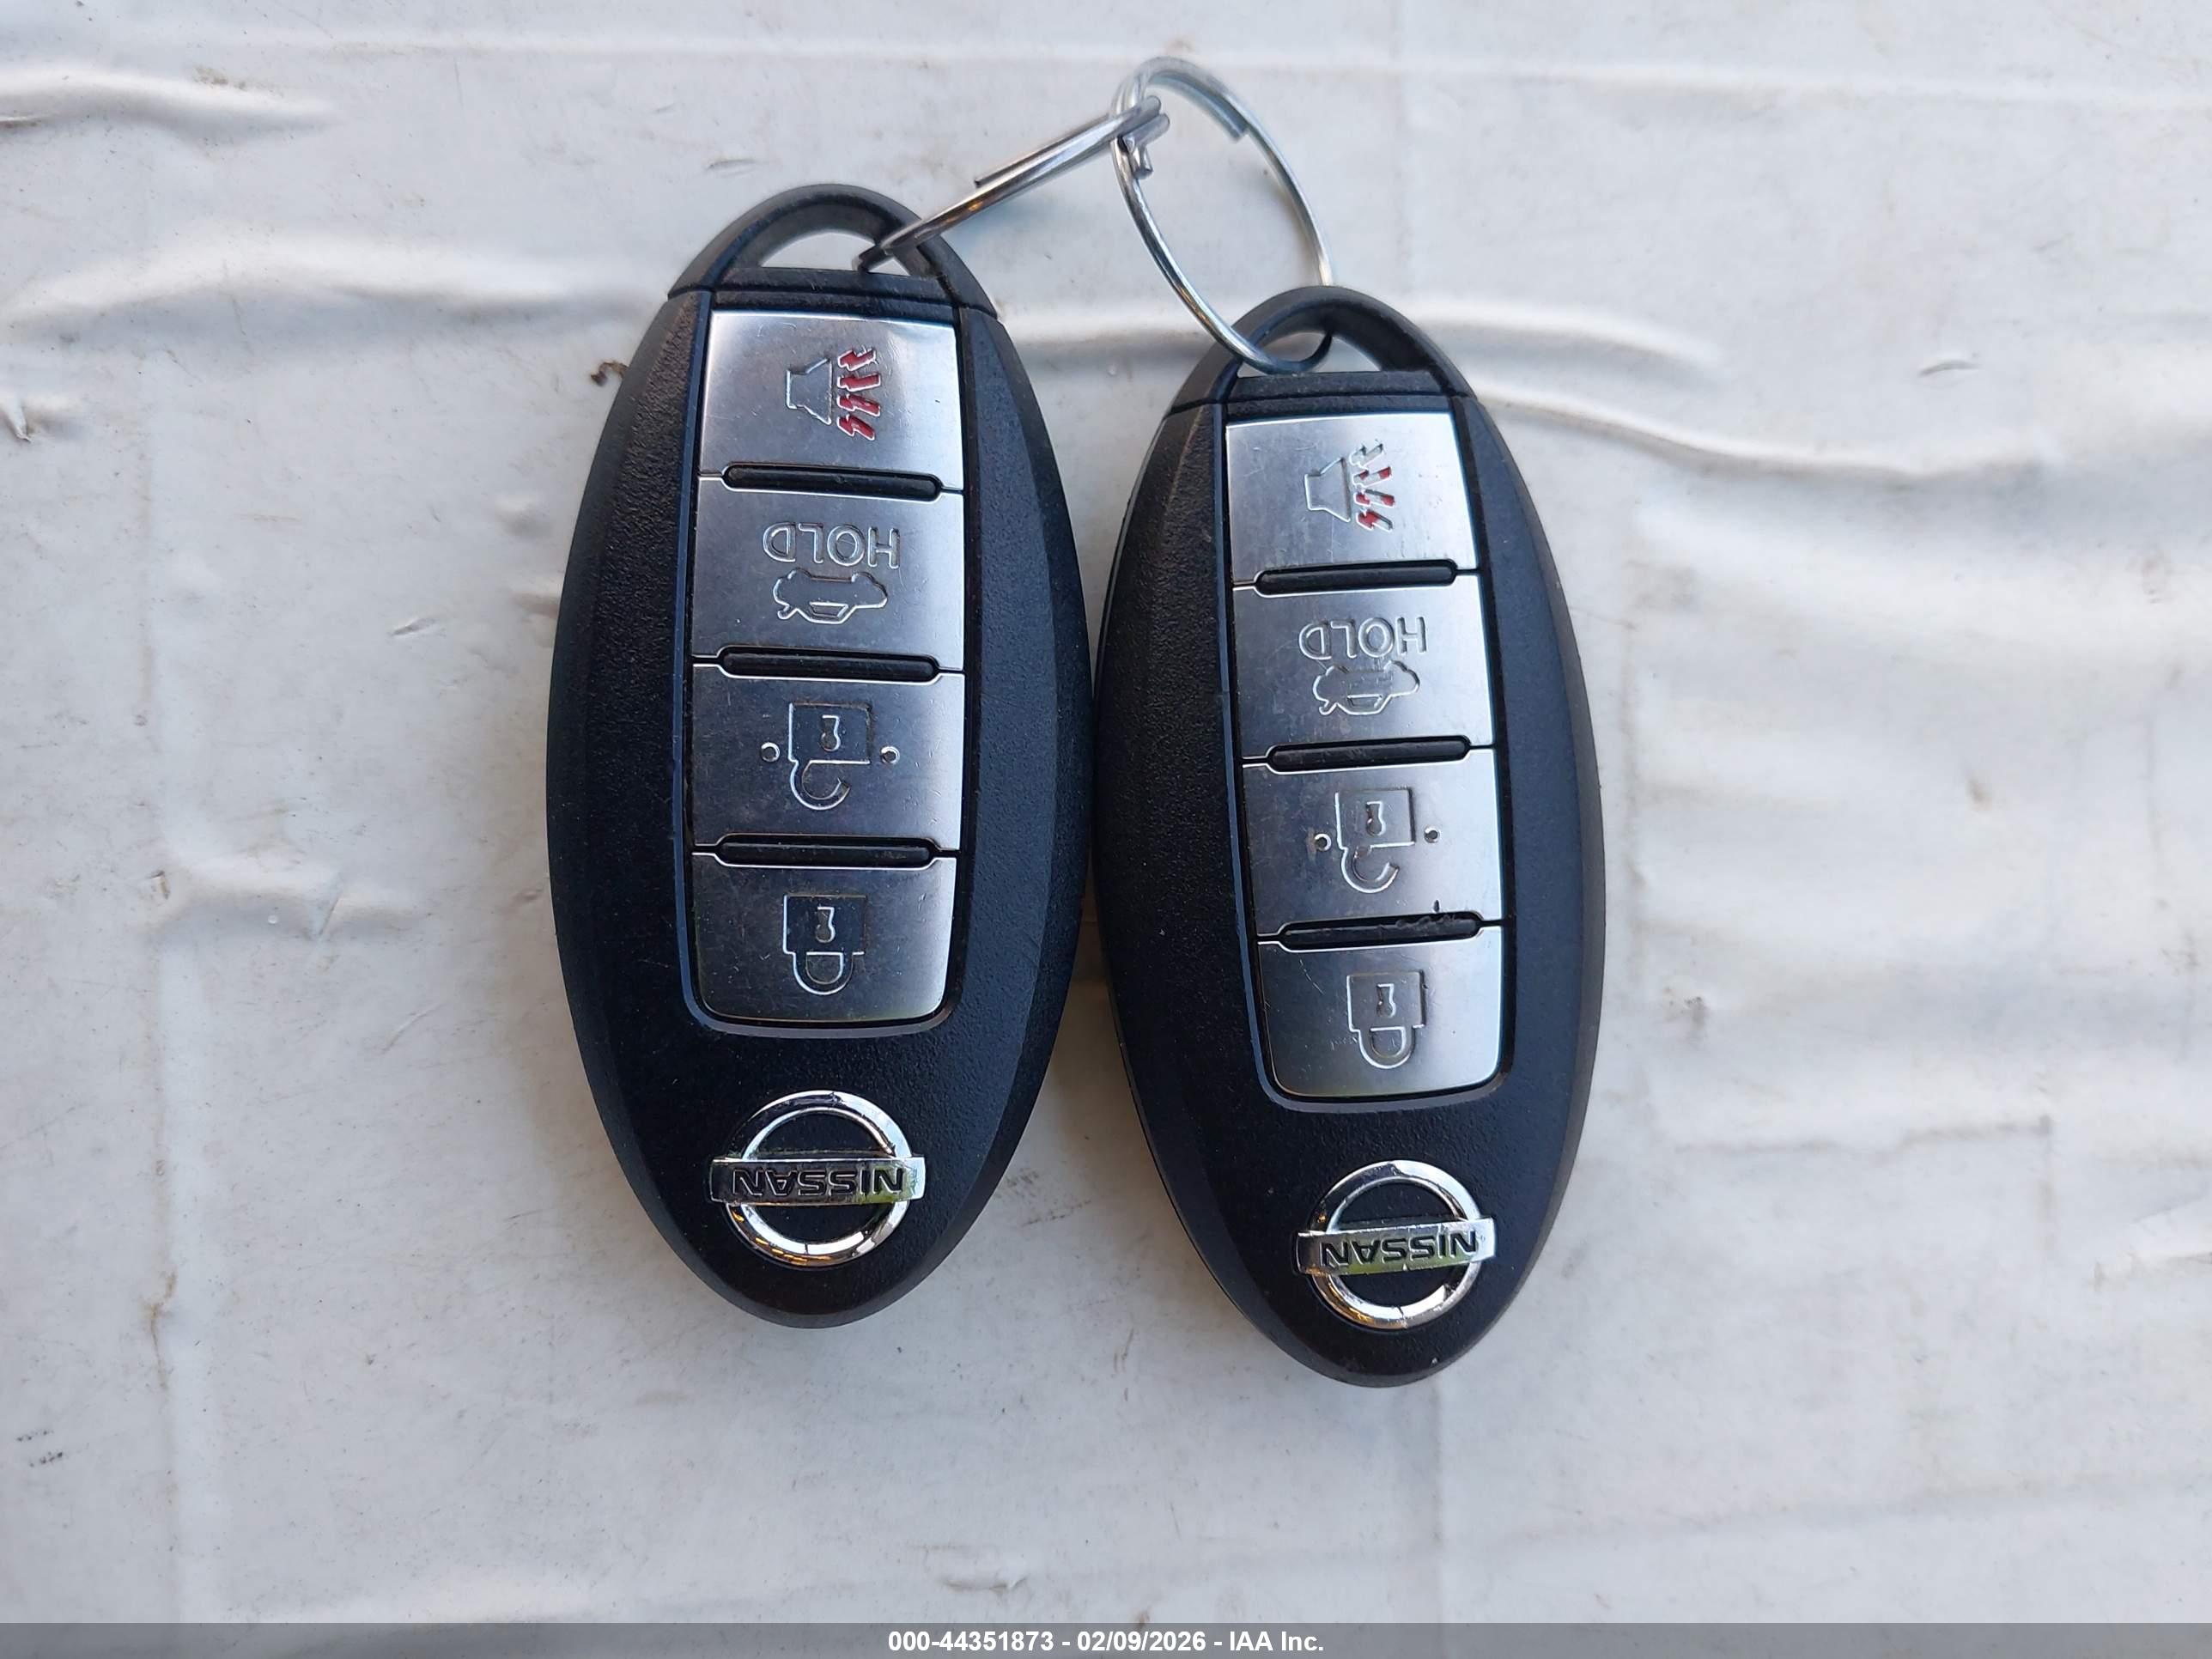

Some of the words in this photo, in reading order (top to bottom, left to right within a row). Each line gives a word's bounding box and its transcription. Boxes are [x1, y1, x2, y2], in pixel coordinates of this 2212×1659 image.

[763, 522, 900, 568] HOLD
[1298, 617, 1427, 660] HOLD
[732, 1169, 903, 1196] NISSAN
[1319, 1229, 1477, 1268] NISSAN
